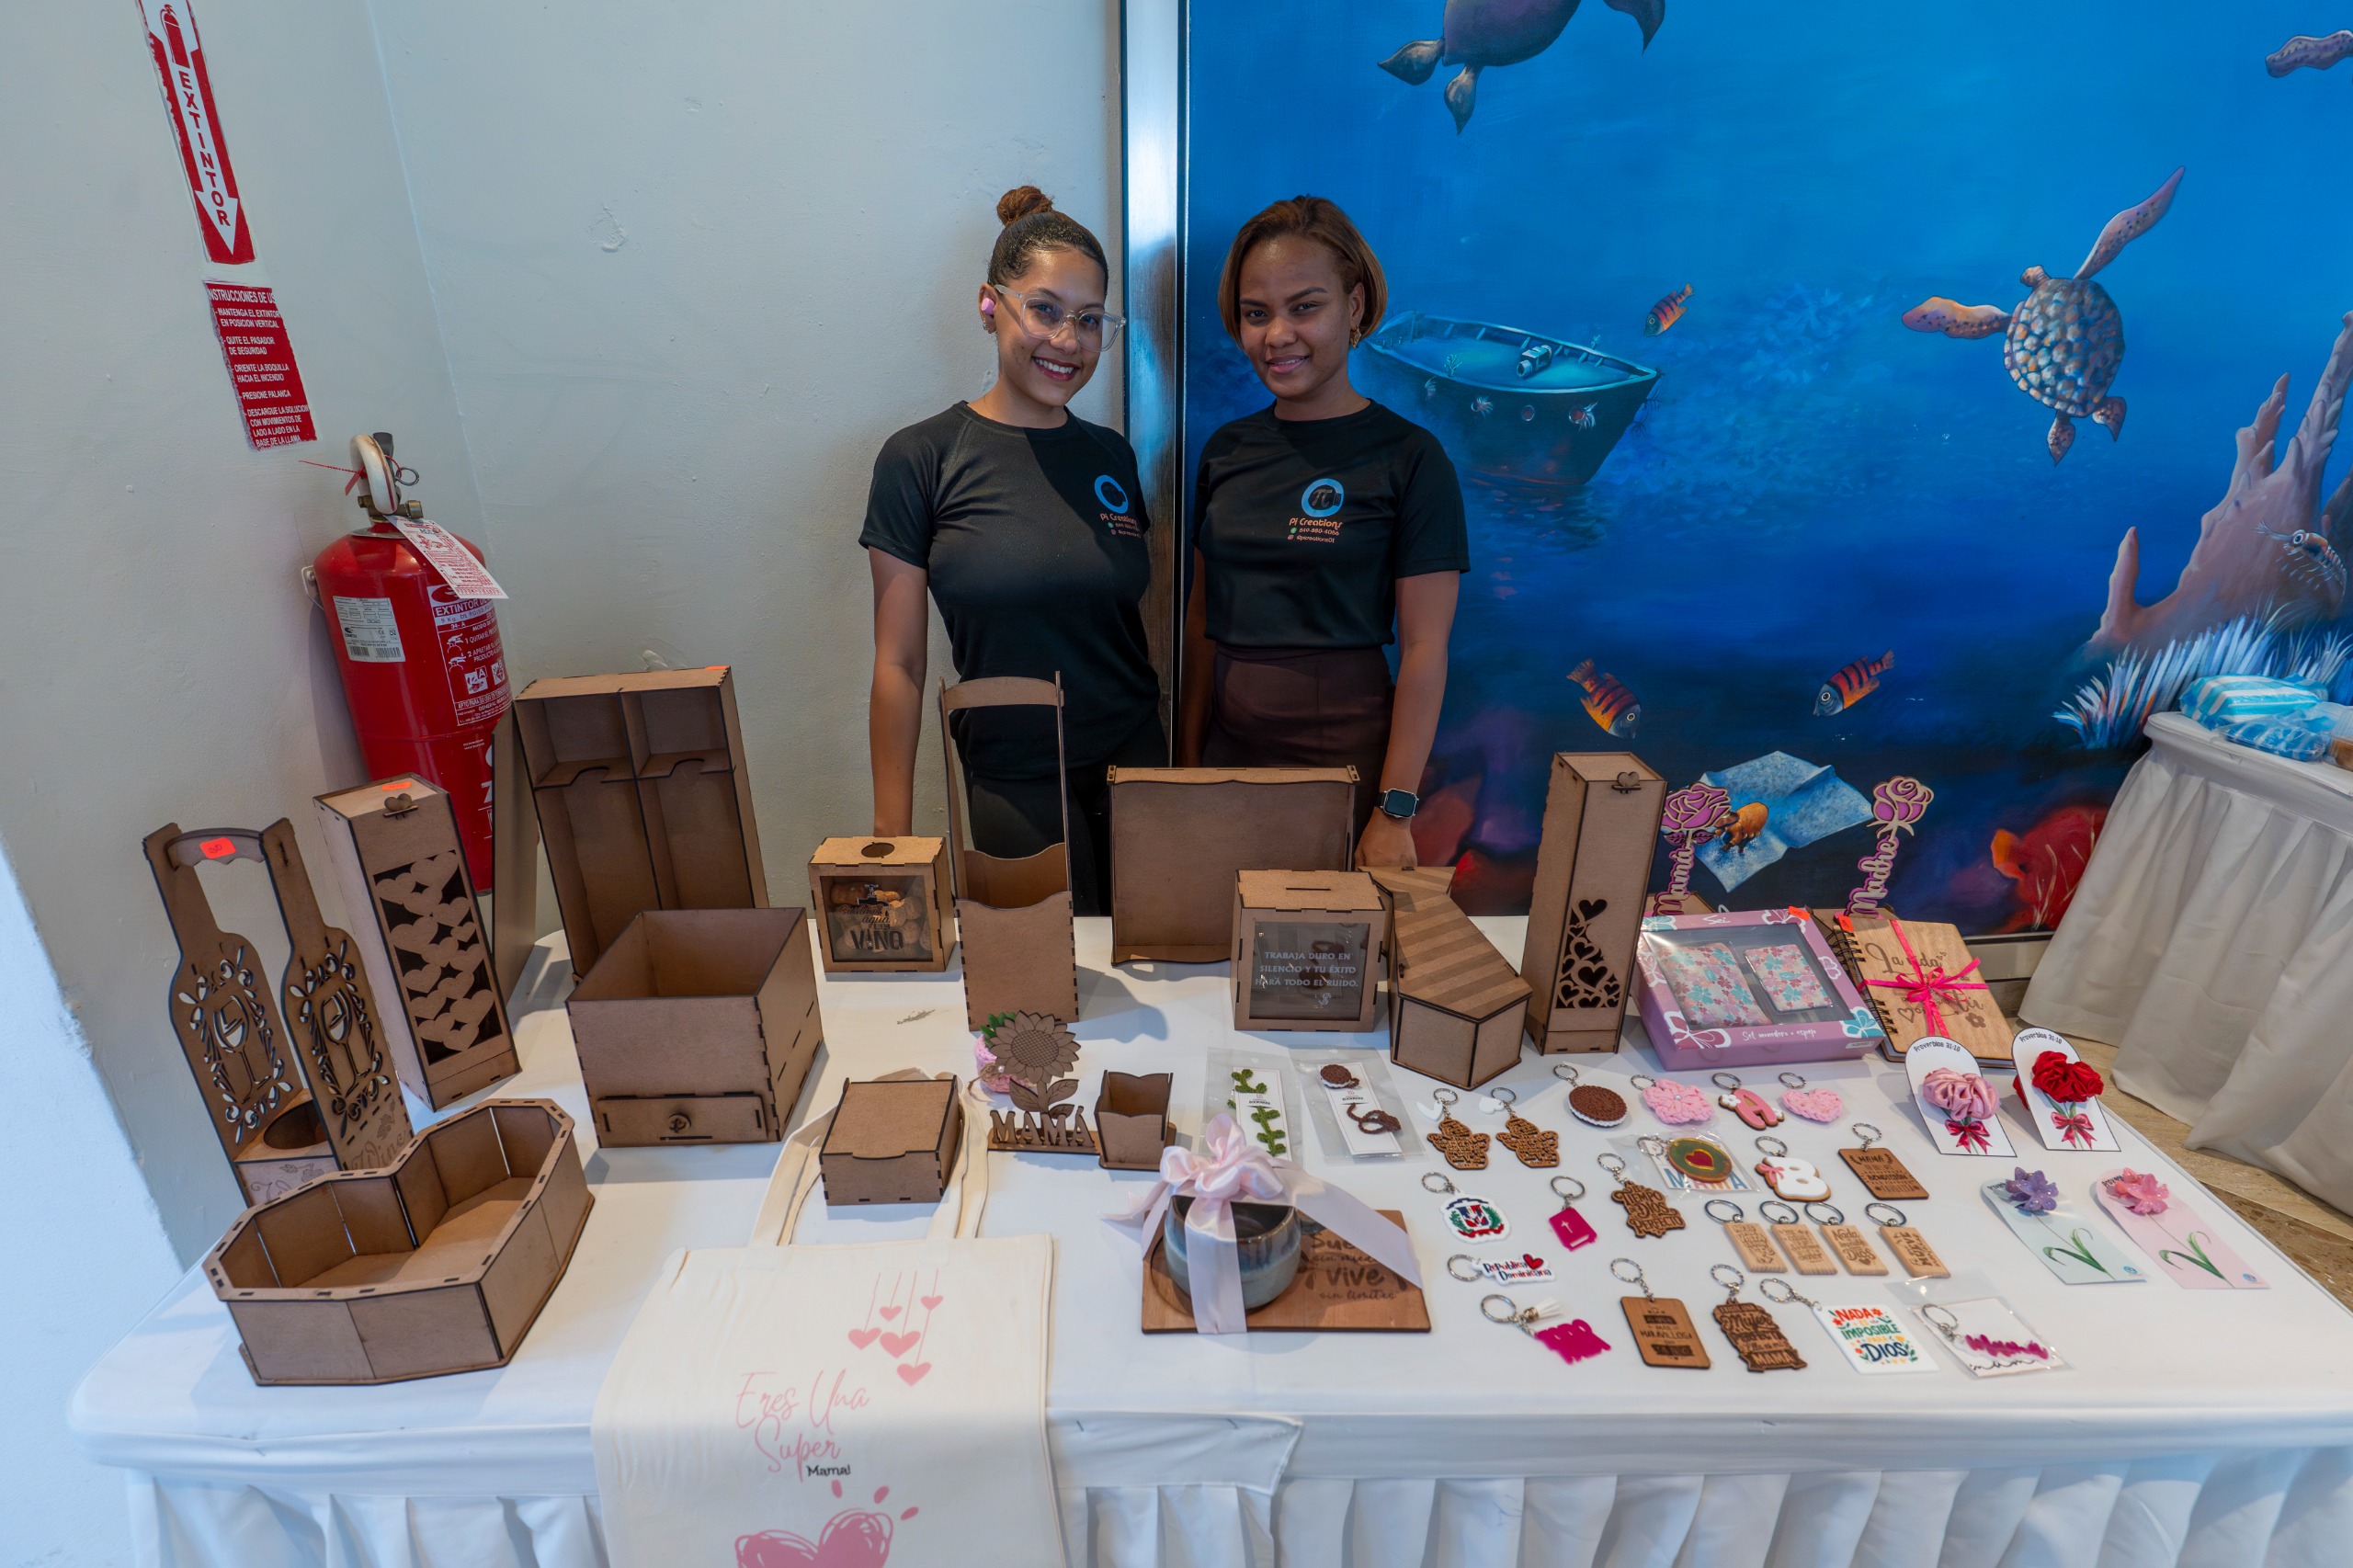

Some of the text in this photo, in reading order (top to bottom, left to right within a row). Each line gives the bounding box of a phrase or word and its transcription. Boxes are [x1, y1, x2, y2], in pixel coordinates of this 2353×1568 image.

[178, 70, 231, 227] EXTINTOR
[210, 288, 276, 304] NSTRUCCIONES DE US
[218, 307, 281, 318] MANTENGA EL EXTINTOR
[220, 318, 279, 328] EN POSICION VERTICAL
[226, 335, 275, 345] QUITE EL PASADOR
[228, 347, 267, 355] DE SEGURIDAD
[234, 363, 290, 372] ORIENTE LA BOQUILLA
[237, 373, 284, 383] HACIA EL INCENDIO
[242, 390, 291, 400] PRESIONE PALANCA
[247, 404, 310, 417] DESCARGUE LA SOLUCION
[250, 418, 262, 427] CON
[262, 415, 294, 426] MOVIMIENTOS
[253, 427, 267, 437] LADO
[272, 426, 286, 436] LADO
[286, 426, 293, 434] EN
[292, 425, 301, 433] LA
[256, 437, 270, 447] BASE
[270, 437, 278, 445] DE
[278, 436, 285, 444] LA
[1289, 517, 1343, 530] Pi Creations
[436, 598, 479, 616] EXTINTOR
[478, 668, 485, 677] A
[850, 928, 904, 950] VINO
[1265, 951, 1351, 960] TRABAJA DURO EN
[1259, 965, 1302, 973] SILENCIO
[1329, 964, 1357, 974] ÉXITO
[1255, 977, 1281, 986] HARÁ
[1327, 979, 1358, 987] RUIDO.
[1742, 1030, 1756, 1041] Set
[2018, 1031, 2047, 1043] Proverbios
[1913, 1040, 1945, 1052] Proverbios
[989, 1105, 1096, 1147] MAMÁ
[1630, 1215, 1684, 1234] PERFECTO
[1832, 1227, 1859, 1242] Nada
[1843, 1247, 1876, 1261] Dios
[1498, 1268, 1552, 1281] Dominicana
[1835, 1308, 1874, 1322] NADA
[1840, 1324, 1902, 1340] IMPOSIBLE
[1859, 1341, 1908, 1362] DIOS
[735, 1368, 870, 1435] Eres Una
[755, 1414, 841, 1483] Super
